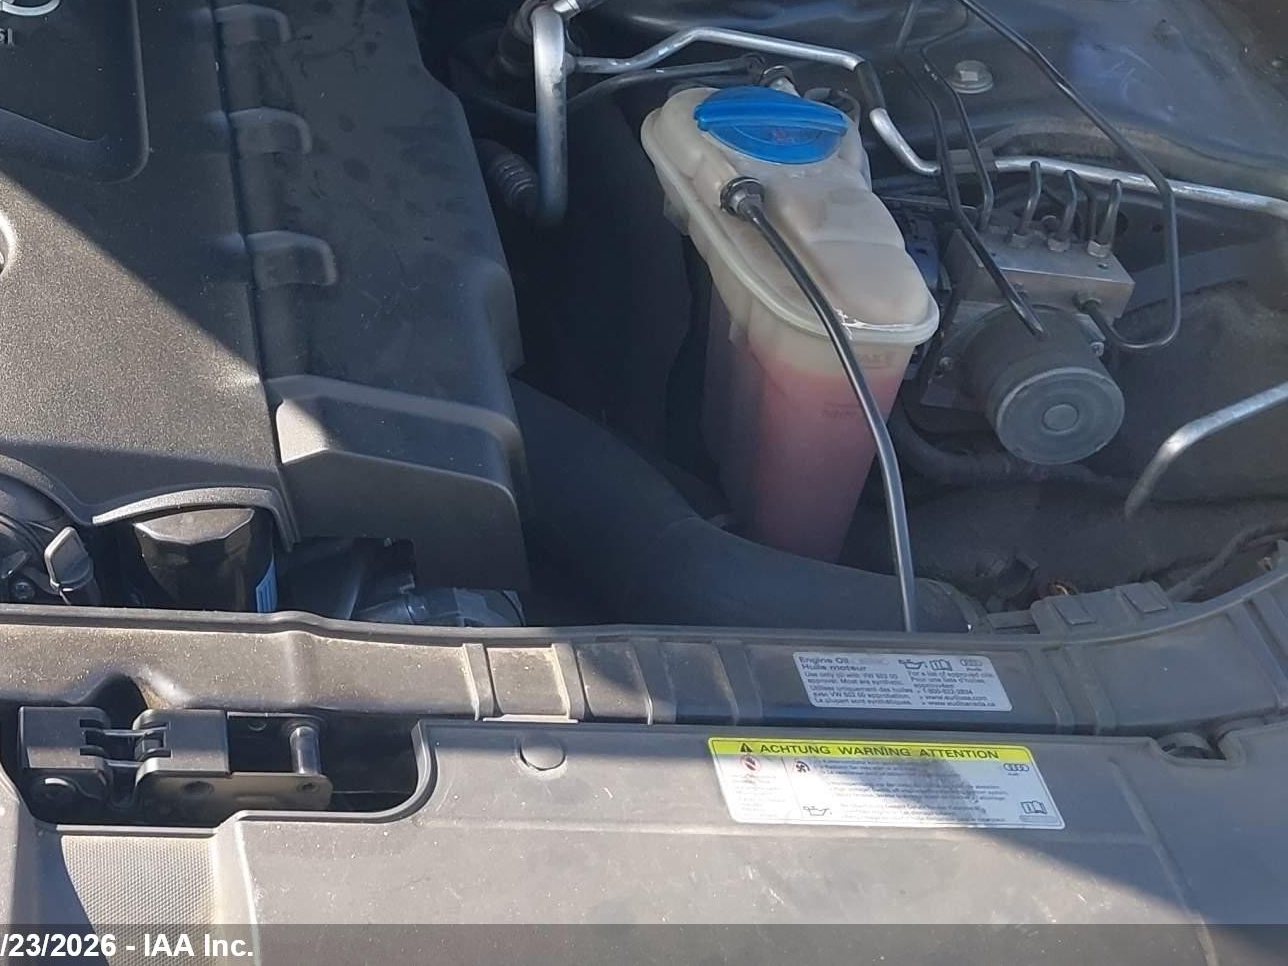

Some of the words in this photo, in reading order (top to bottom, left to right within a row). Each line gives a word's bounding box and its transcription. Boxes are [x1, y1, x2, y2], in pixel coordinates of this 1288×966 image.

[760, 744, 831, 755] ACHTUNG
[838, 747, 912, 757] WARNING
[919, 748, 999, 759] ATTENTION
